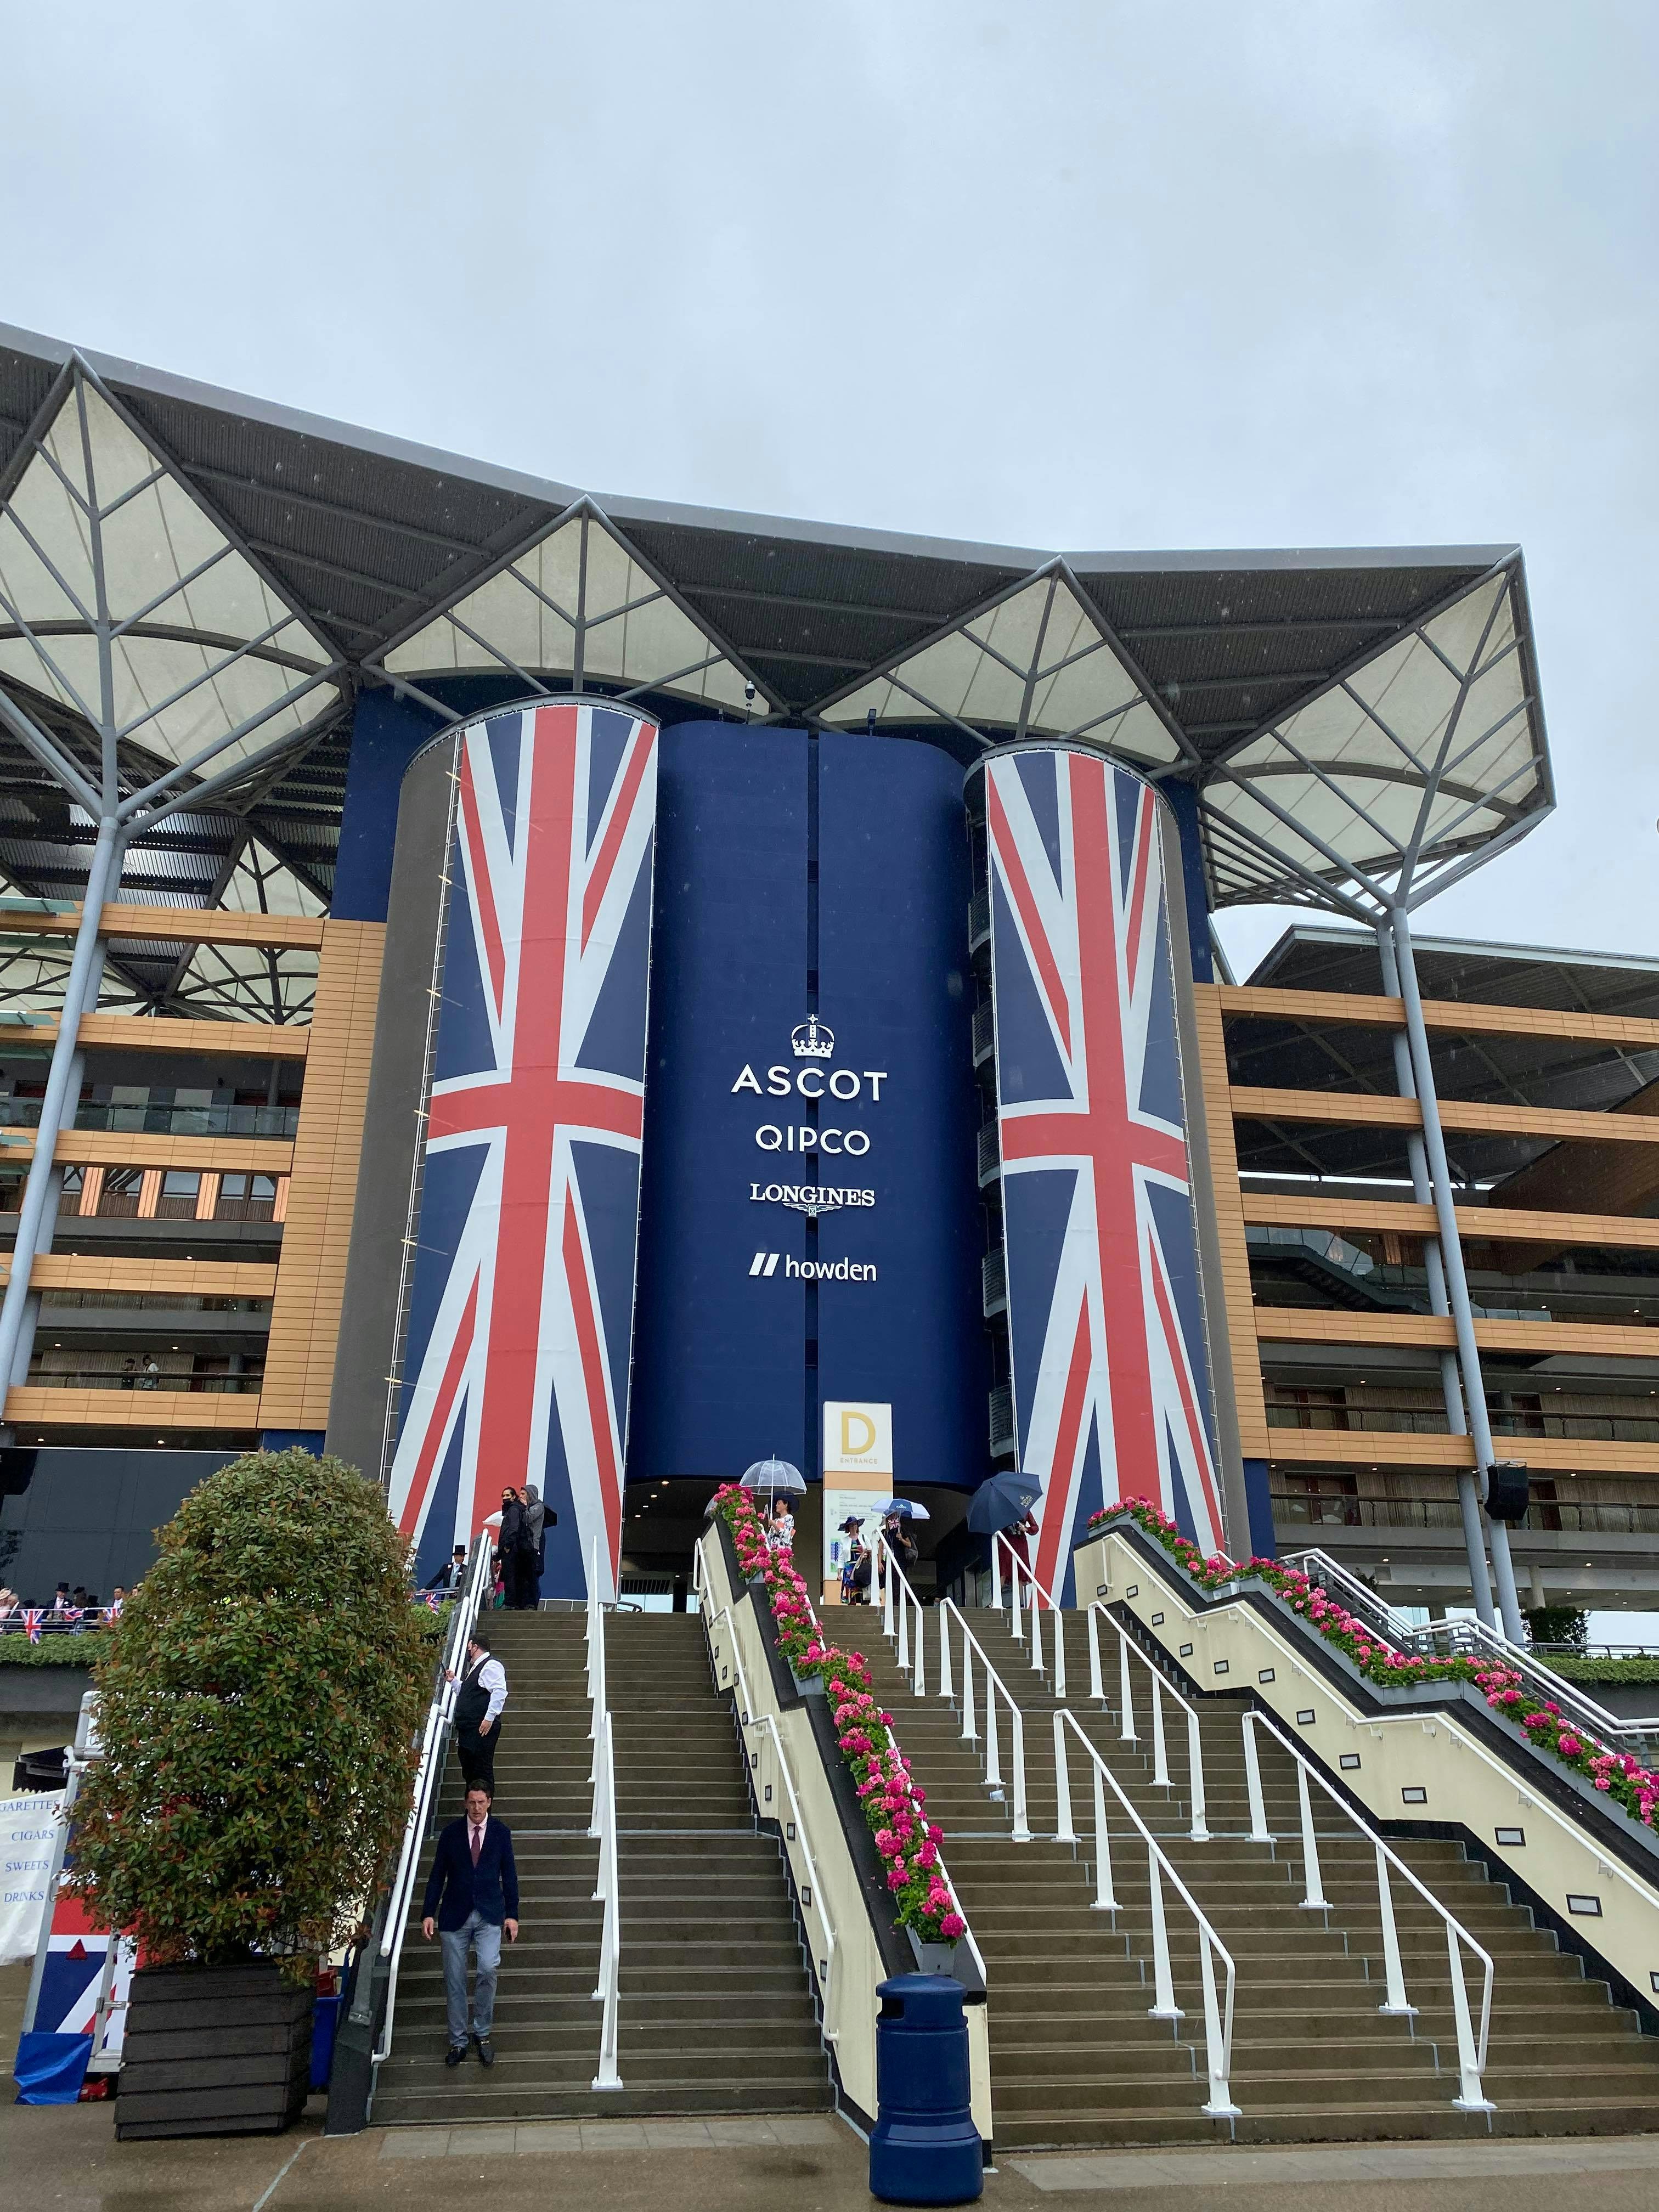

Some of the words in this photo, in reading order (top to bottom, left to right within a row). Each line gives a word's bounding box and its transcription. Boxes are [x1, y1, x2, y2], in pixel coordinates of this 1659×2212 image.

[731, 1063, 888, 1101] ASCOT
[755, 1125, 870, 1155] QIPCO
[750, 1183, 875, 1207] LONGINES
[786, 1254, 877, 1281] howden
[842, 1411, 876, 1455] D
[12, 1830, 54, 1841] CIGARS
[5, 1860, 49, 1872] SWEETS
[4, 1891, 44, 1903] DRINKS
